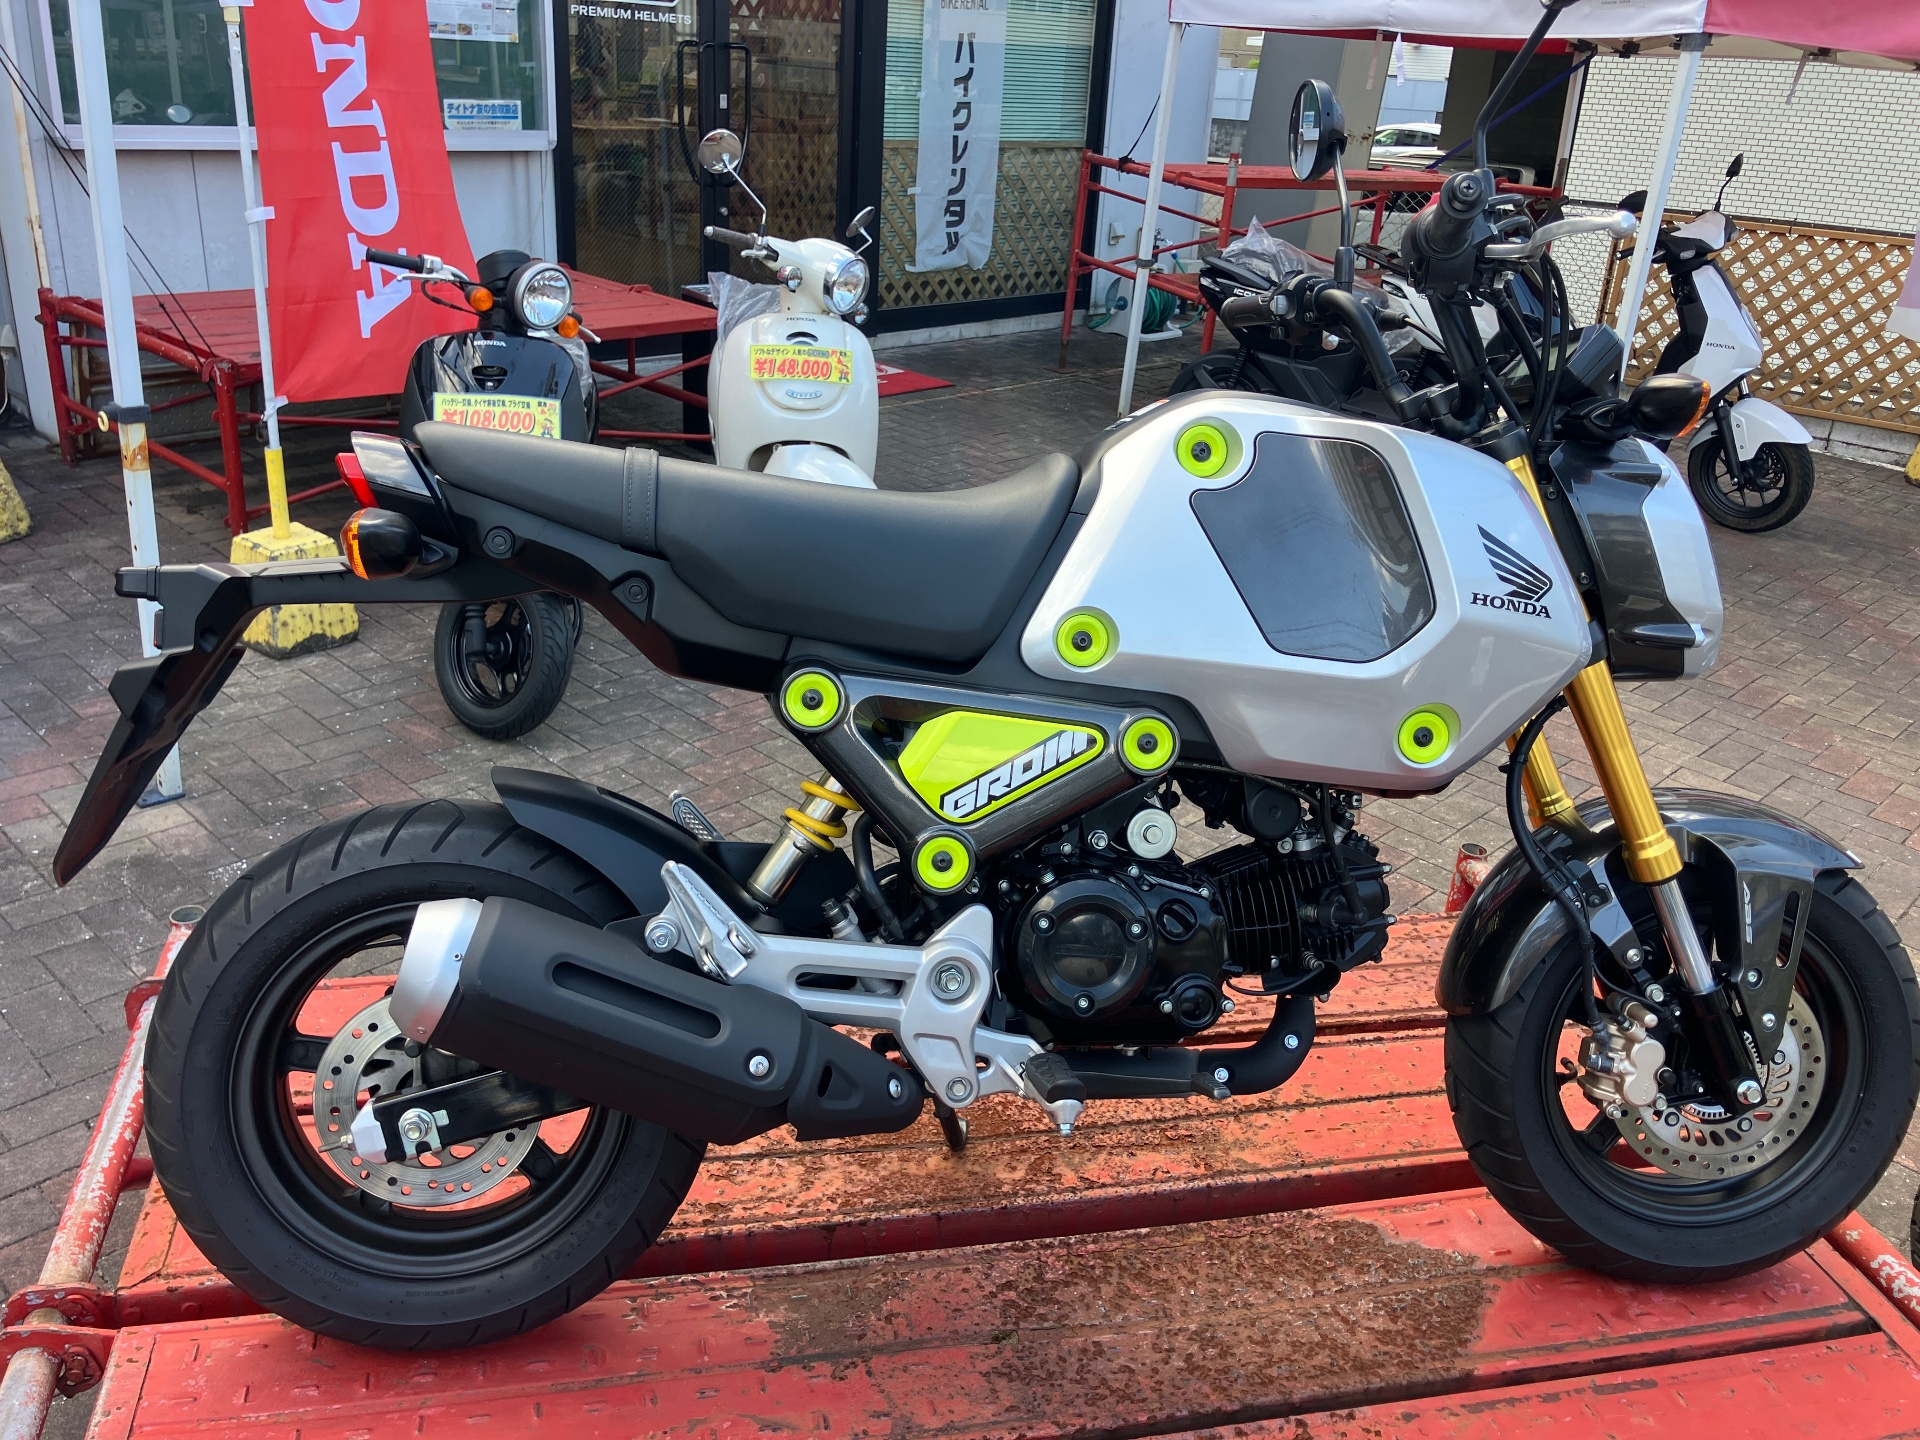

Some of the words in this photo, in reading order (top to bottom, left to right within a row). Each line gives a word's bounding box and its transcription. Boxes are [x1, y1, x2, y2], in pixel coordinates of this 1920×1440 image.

[570, 4, 632, 20] PREMIUM
[634, 10, 692, 25] HELMETS
[942, 32, 976, 256] バイクレンタル
[473, 339, 507, 348] HONDA
[1706, 341, 1736, 350] HONDA
[1469, 591, 1553, 620] HONDA
[941, 730, 1089, 819] GROM
[1742, 880, 1753, 945] ABS
